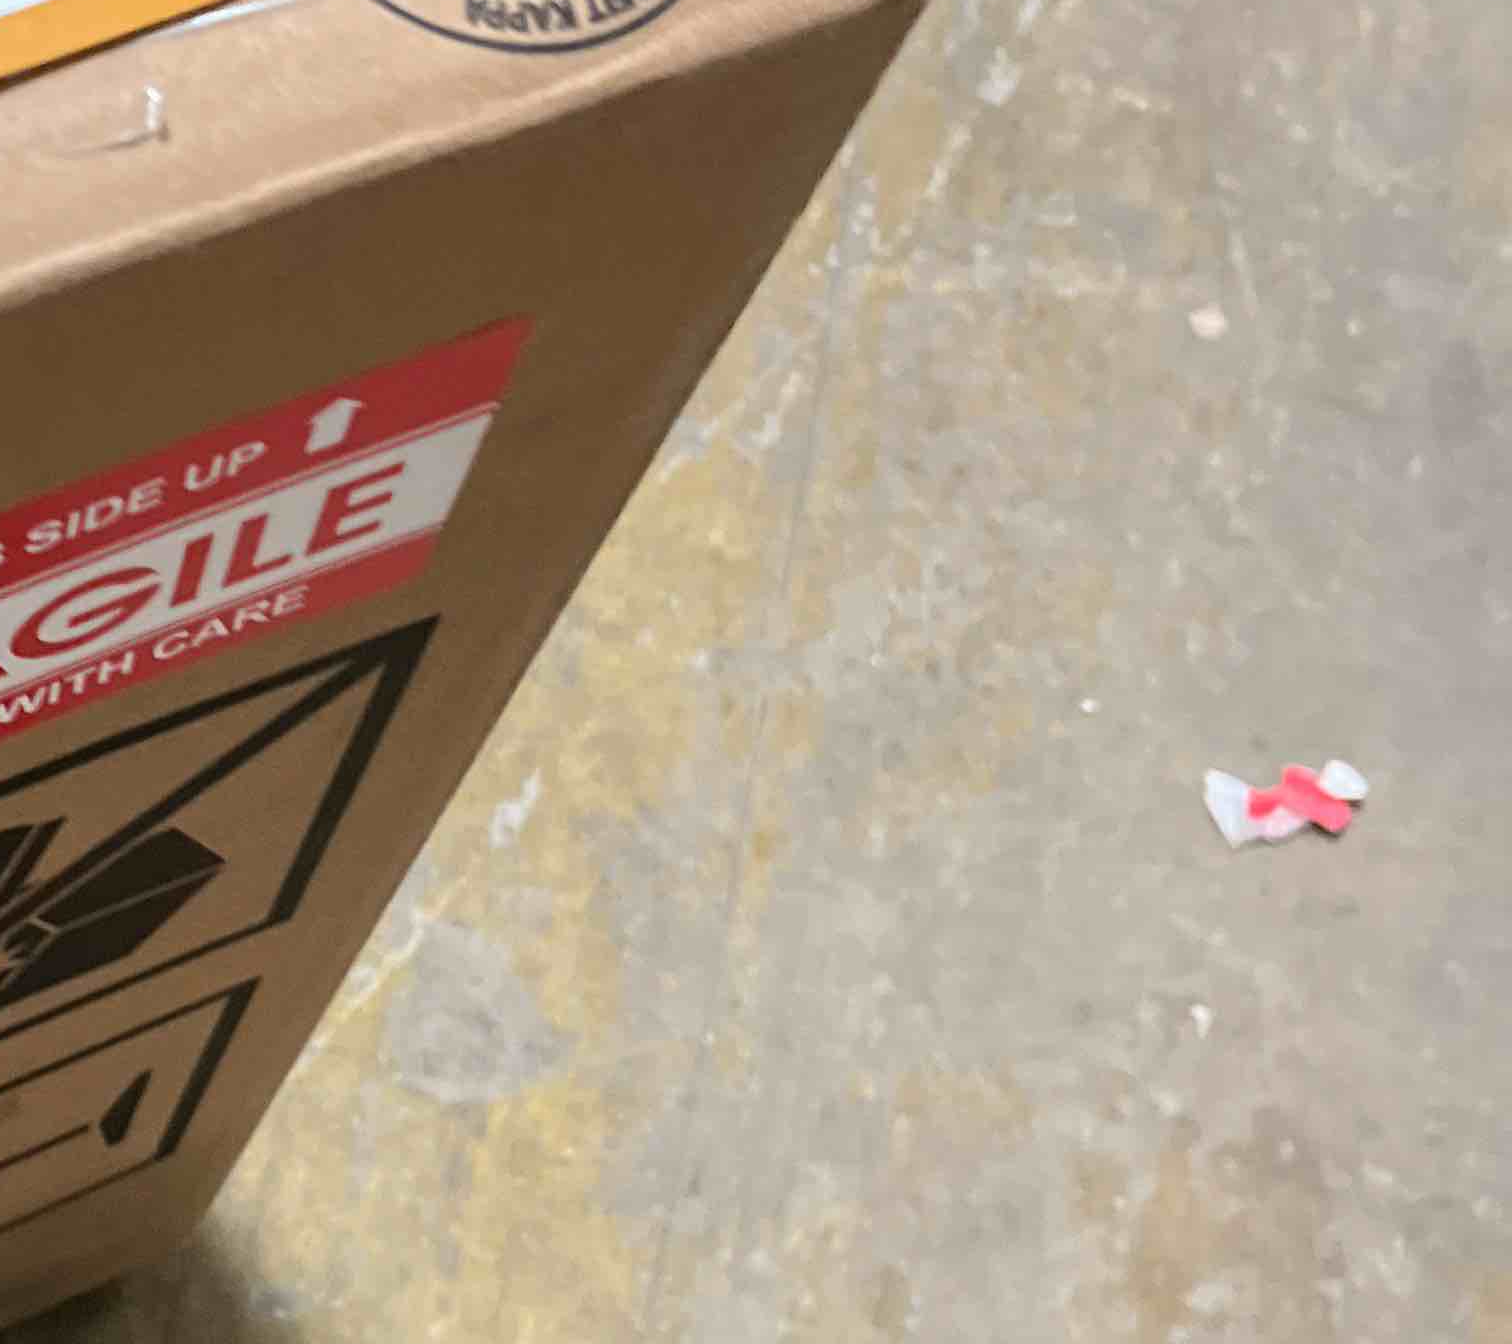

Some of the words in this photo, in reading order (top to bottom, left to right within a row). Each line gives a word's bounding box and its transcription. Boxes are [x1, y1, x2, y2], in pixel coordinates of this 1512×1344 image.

[23, 476, 168, 556] SIDE
[182, 438, 271, 500] UP
[151, 584, 312, 660] CARE
